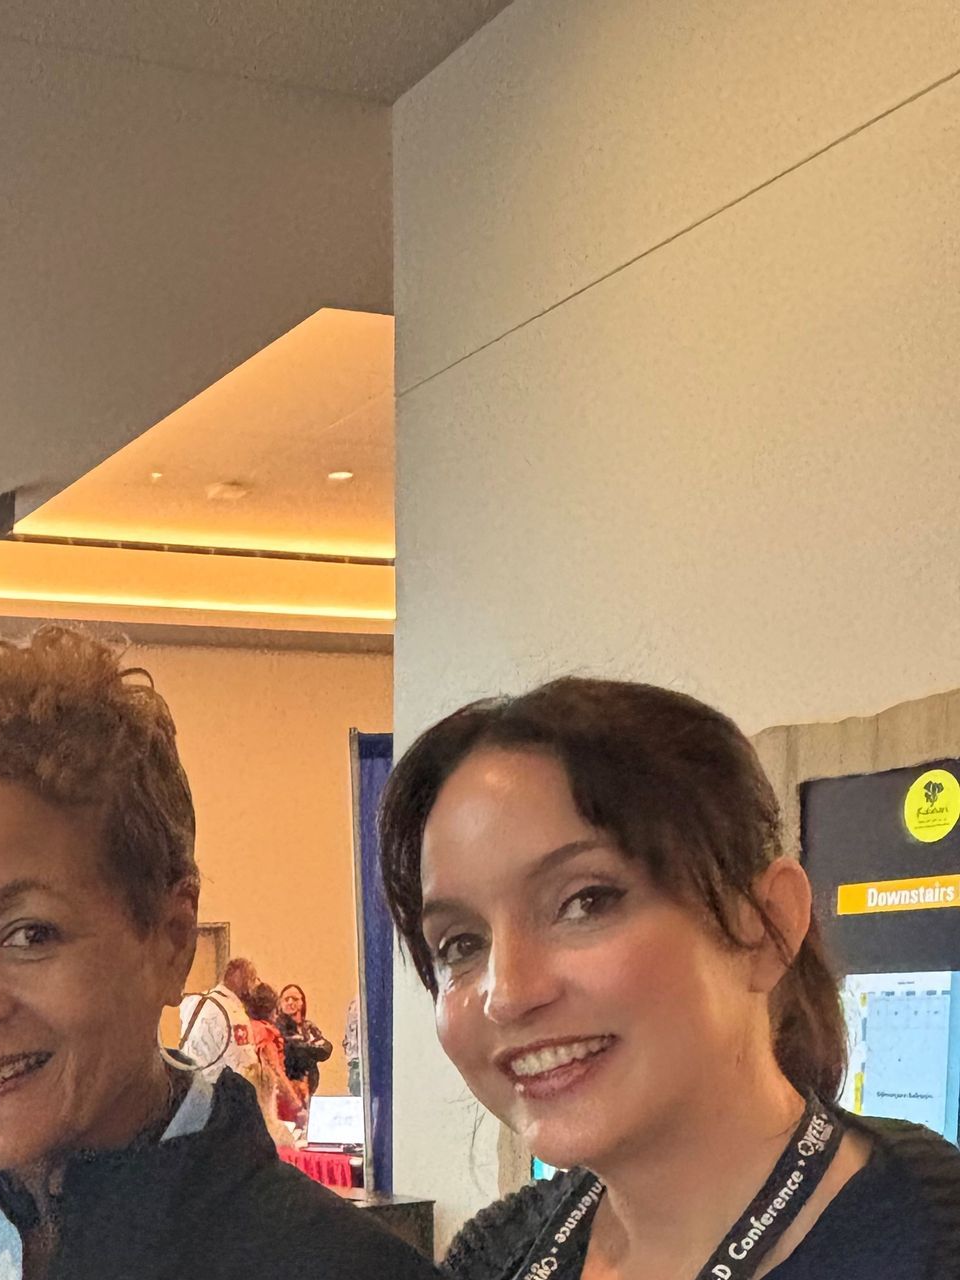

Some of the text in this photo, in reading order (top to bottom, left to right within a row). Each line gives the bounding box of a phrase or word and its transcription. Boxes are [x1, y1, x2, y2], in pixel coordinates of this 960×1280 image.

[867, 881, 955, 907] Downstairs
[555, 1182, 604, 1243] nference
[729, 1170, 804, 1260] Conference
